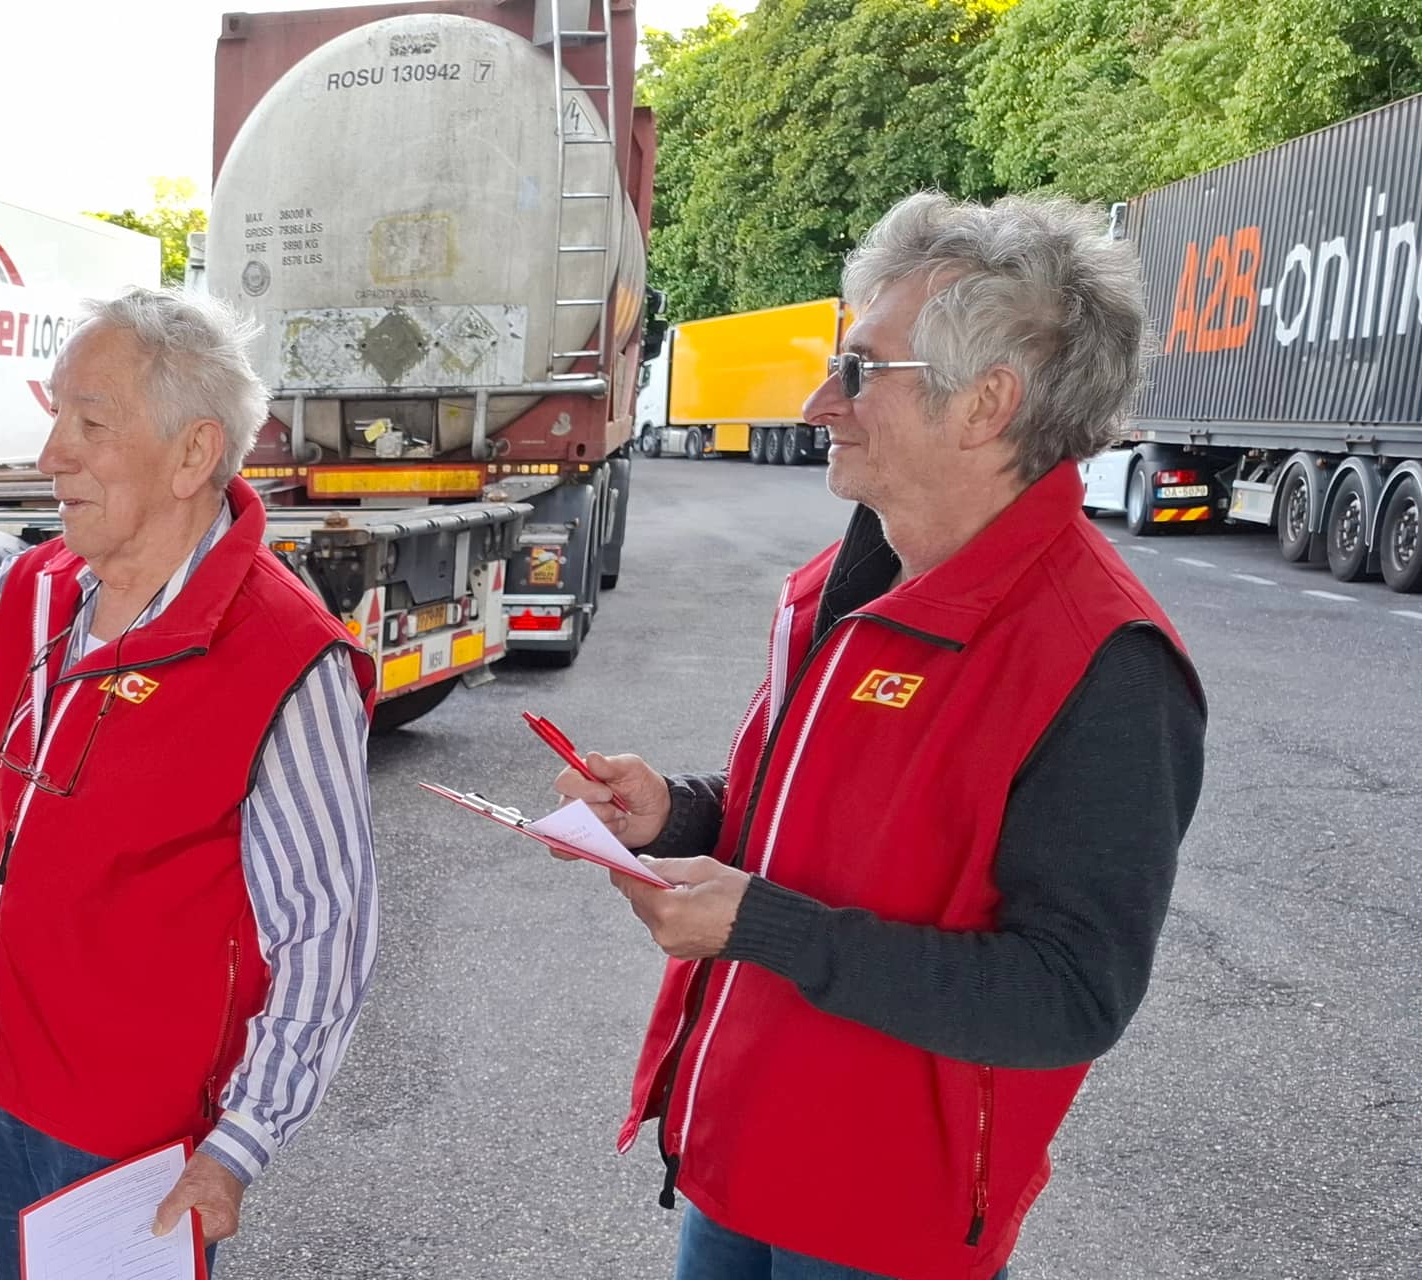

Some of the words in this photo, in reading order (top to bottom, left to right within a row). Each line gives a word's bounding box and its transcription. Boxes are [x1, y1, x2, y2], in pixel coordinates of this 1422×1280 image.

[327, 67, 384, 91] ROSU
[392, 63, 461, 82] 130942
[479, 63, 491, 81] 7
[245, 225, 274, 238] GROSS
[1165, 186, 1422, 353] A2B-onlin
[853, 671, 921, 706] ACE
